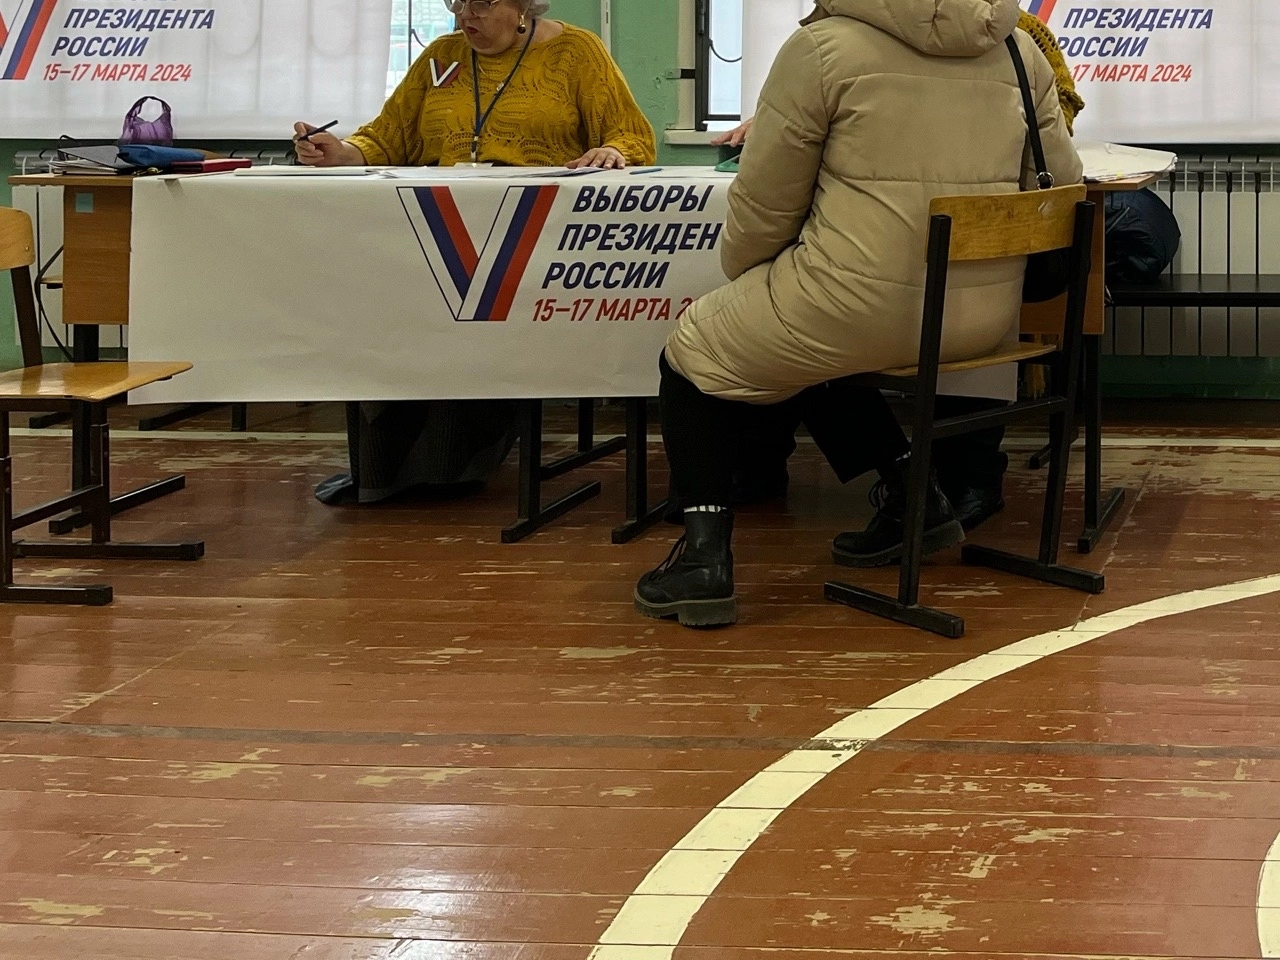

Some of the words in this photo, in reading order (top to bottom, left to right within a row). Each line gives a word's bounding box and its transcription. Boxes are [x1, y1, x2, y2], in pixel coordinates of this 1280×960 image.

[63, 8, 215, 32] ПРЕЗИДЕНТА
[1063, 8, 1213, 32] ПРЕЗИДЕНТА
[51, 36, 149, 57] РОССИИ
[91, 64, 147, 81] МАРТА
[151, 64, 192, 82] 2024
[1090, 64, 1146, 82] МАРТА
[1151, 64, 1192, 82] 2024
[572, 185, 714, 212] ВЫБОРЫ
[557, 223, 723, 255] ПРЕЗИДЕН
[541, 261, 670, 289] РОССИИ
[595, 298, 672, 321] МАРТА
